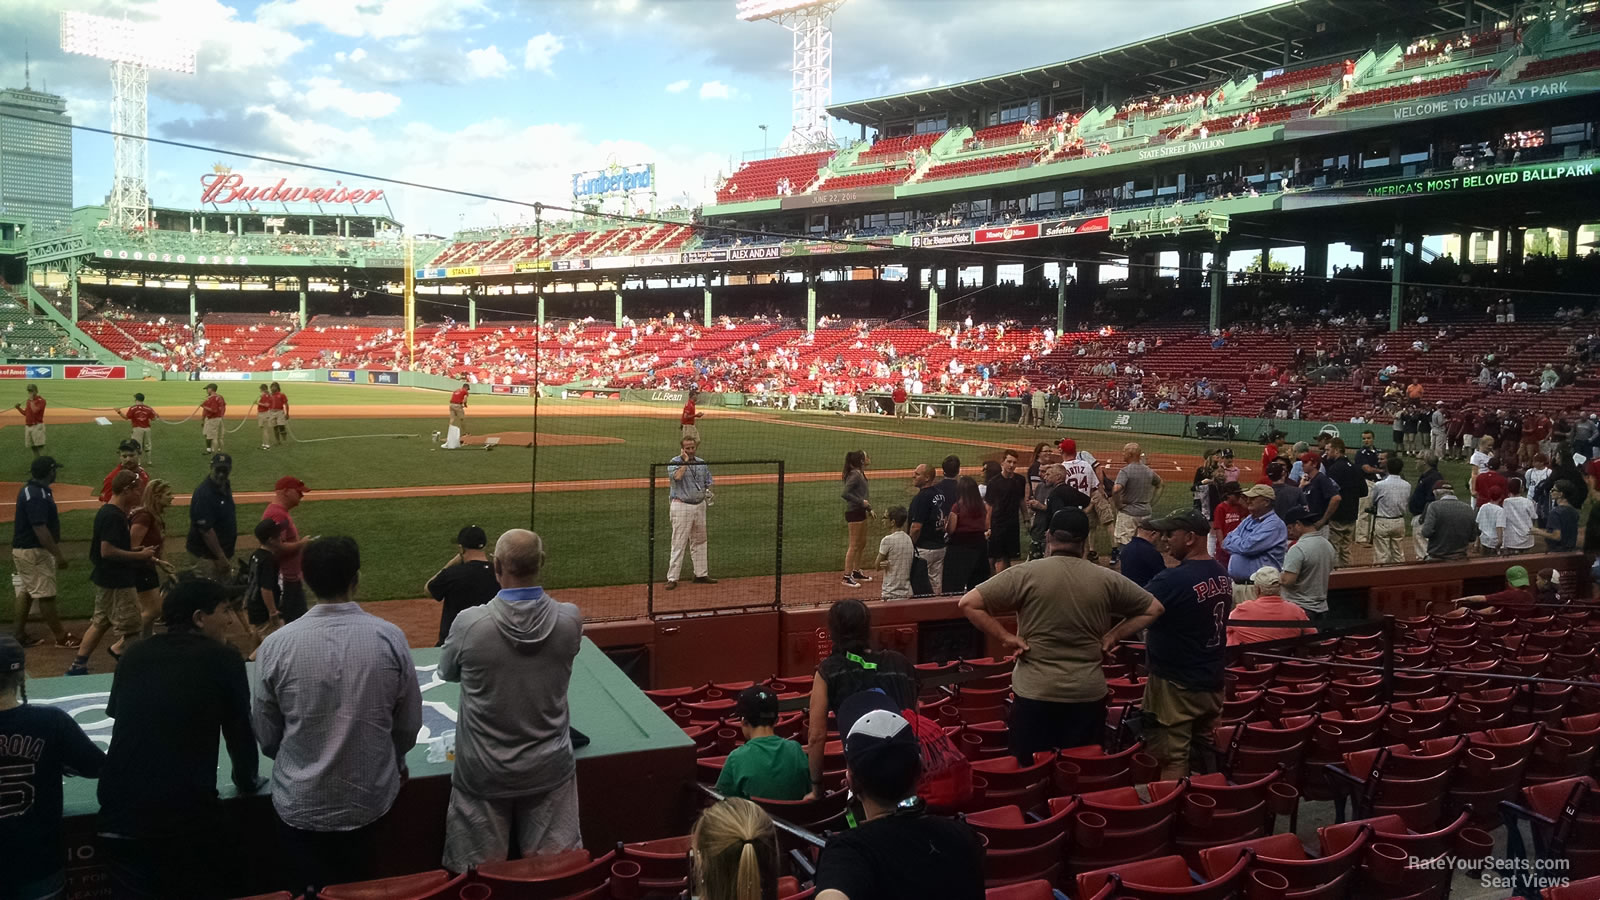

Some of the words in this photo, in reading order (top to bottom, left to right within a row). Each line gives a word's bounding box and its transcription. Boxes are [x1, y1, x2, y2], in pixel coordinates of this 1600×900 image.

[1393, 101, 1448, 119] WELCOME
[1453, 98, 1468, 110] TO
[1473, 87, 1525, 107] FENWAY
[1531, 81, 1568, 98] PARK
[1139, 149, 1159, 160] STATE
[1160, 145, 1186, 156] STREET
[1188, 138, 1225, 152] PAVILION
[573, 164, 650, 196] Cumberland
[1366, 182, 1423, 197] AMERICA'S
[1427, 178, 1459, 192] MOST
[1463, 172, 1518, 188] BELOVED
[1522, 164, 1593, 182] BALLPARK
[200, 173, 384, 204] Budweiser
[812, 195, 828, 204] JUNE
[842, 192, 857, 201] 2016
[1046, 225, 1077, 236] Safelite
[923, 236, 933, 246] The
[933, 235, 952, 245] Boston
[953, 234, 969, 244] Globe
[732, 250, 748, 259] ALEX
[749, 249, 764, 258] AND
[766, 247, 779, 257] ANI
[1371, 769, 1380, 779] D
[1565, 805, 1576, 816] E
